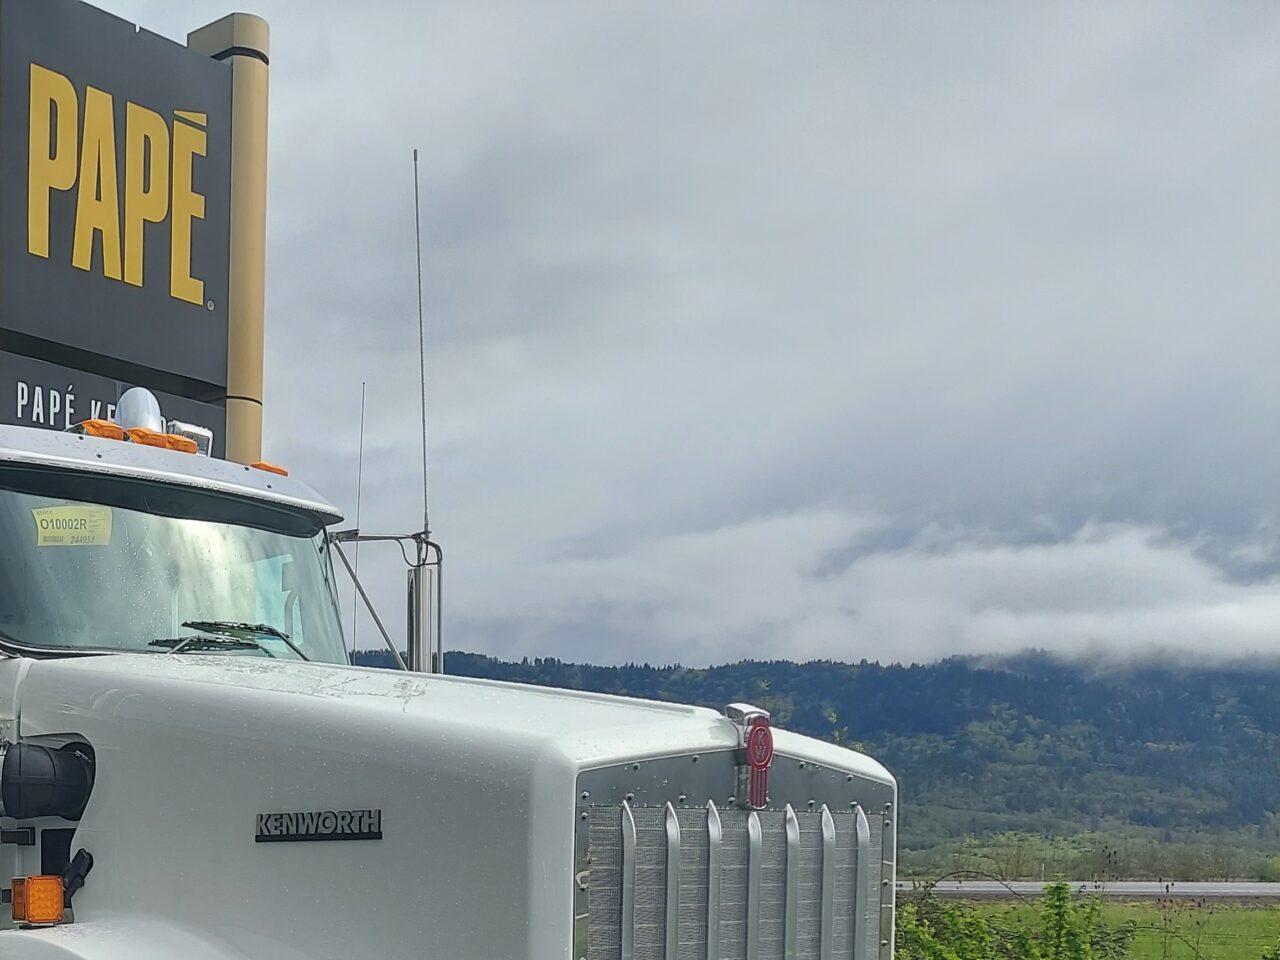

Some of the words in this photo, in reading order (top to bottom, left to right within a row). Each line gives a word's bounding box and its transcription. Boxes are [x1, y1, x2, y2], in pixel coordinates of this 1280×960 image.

[27, 62, 208, 307] PAPÉ
[16, 381, 76, 429] PAPÉ
[255, 809, 382, 838] KENWORTH
